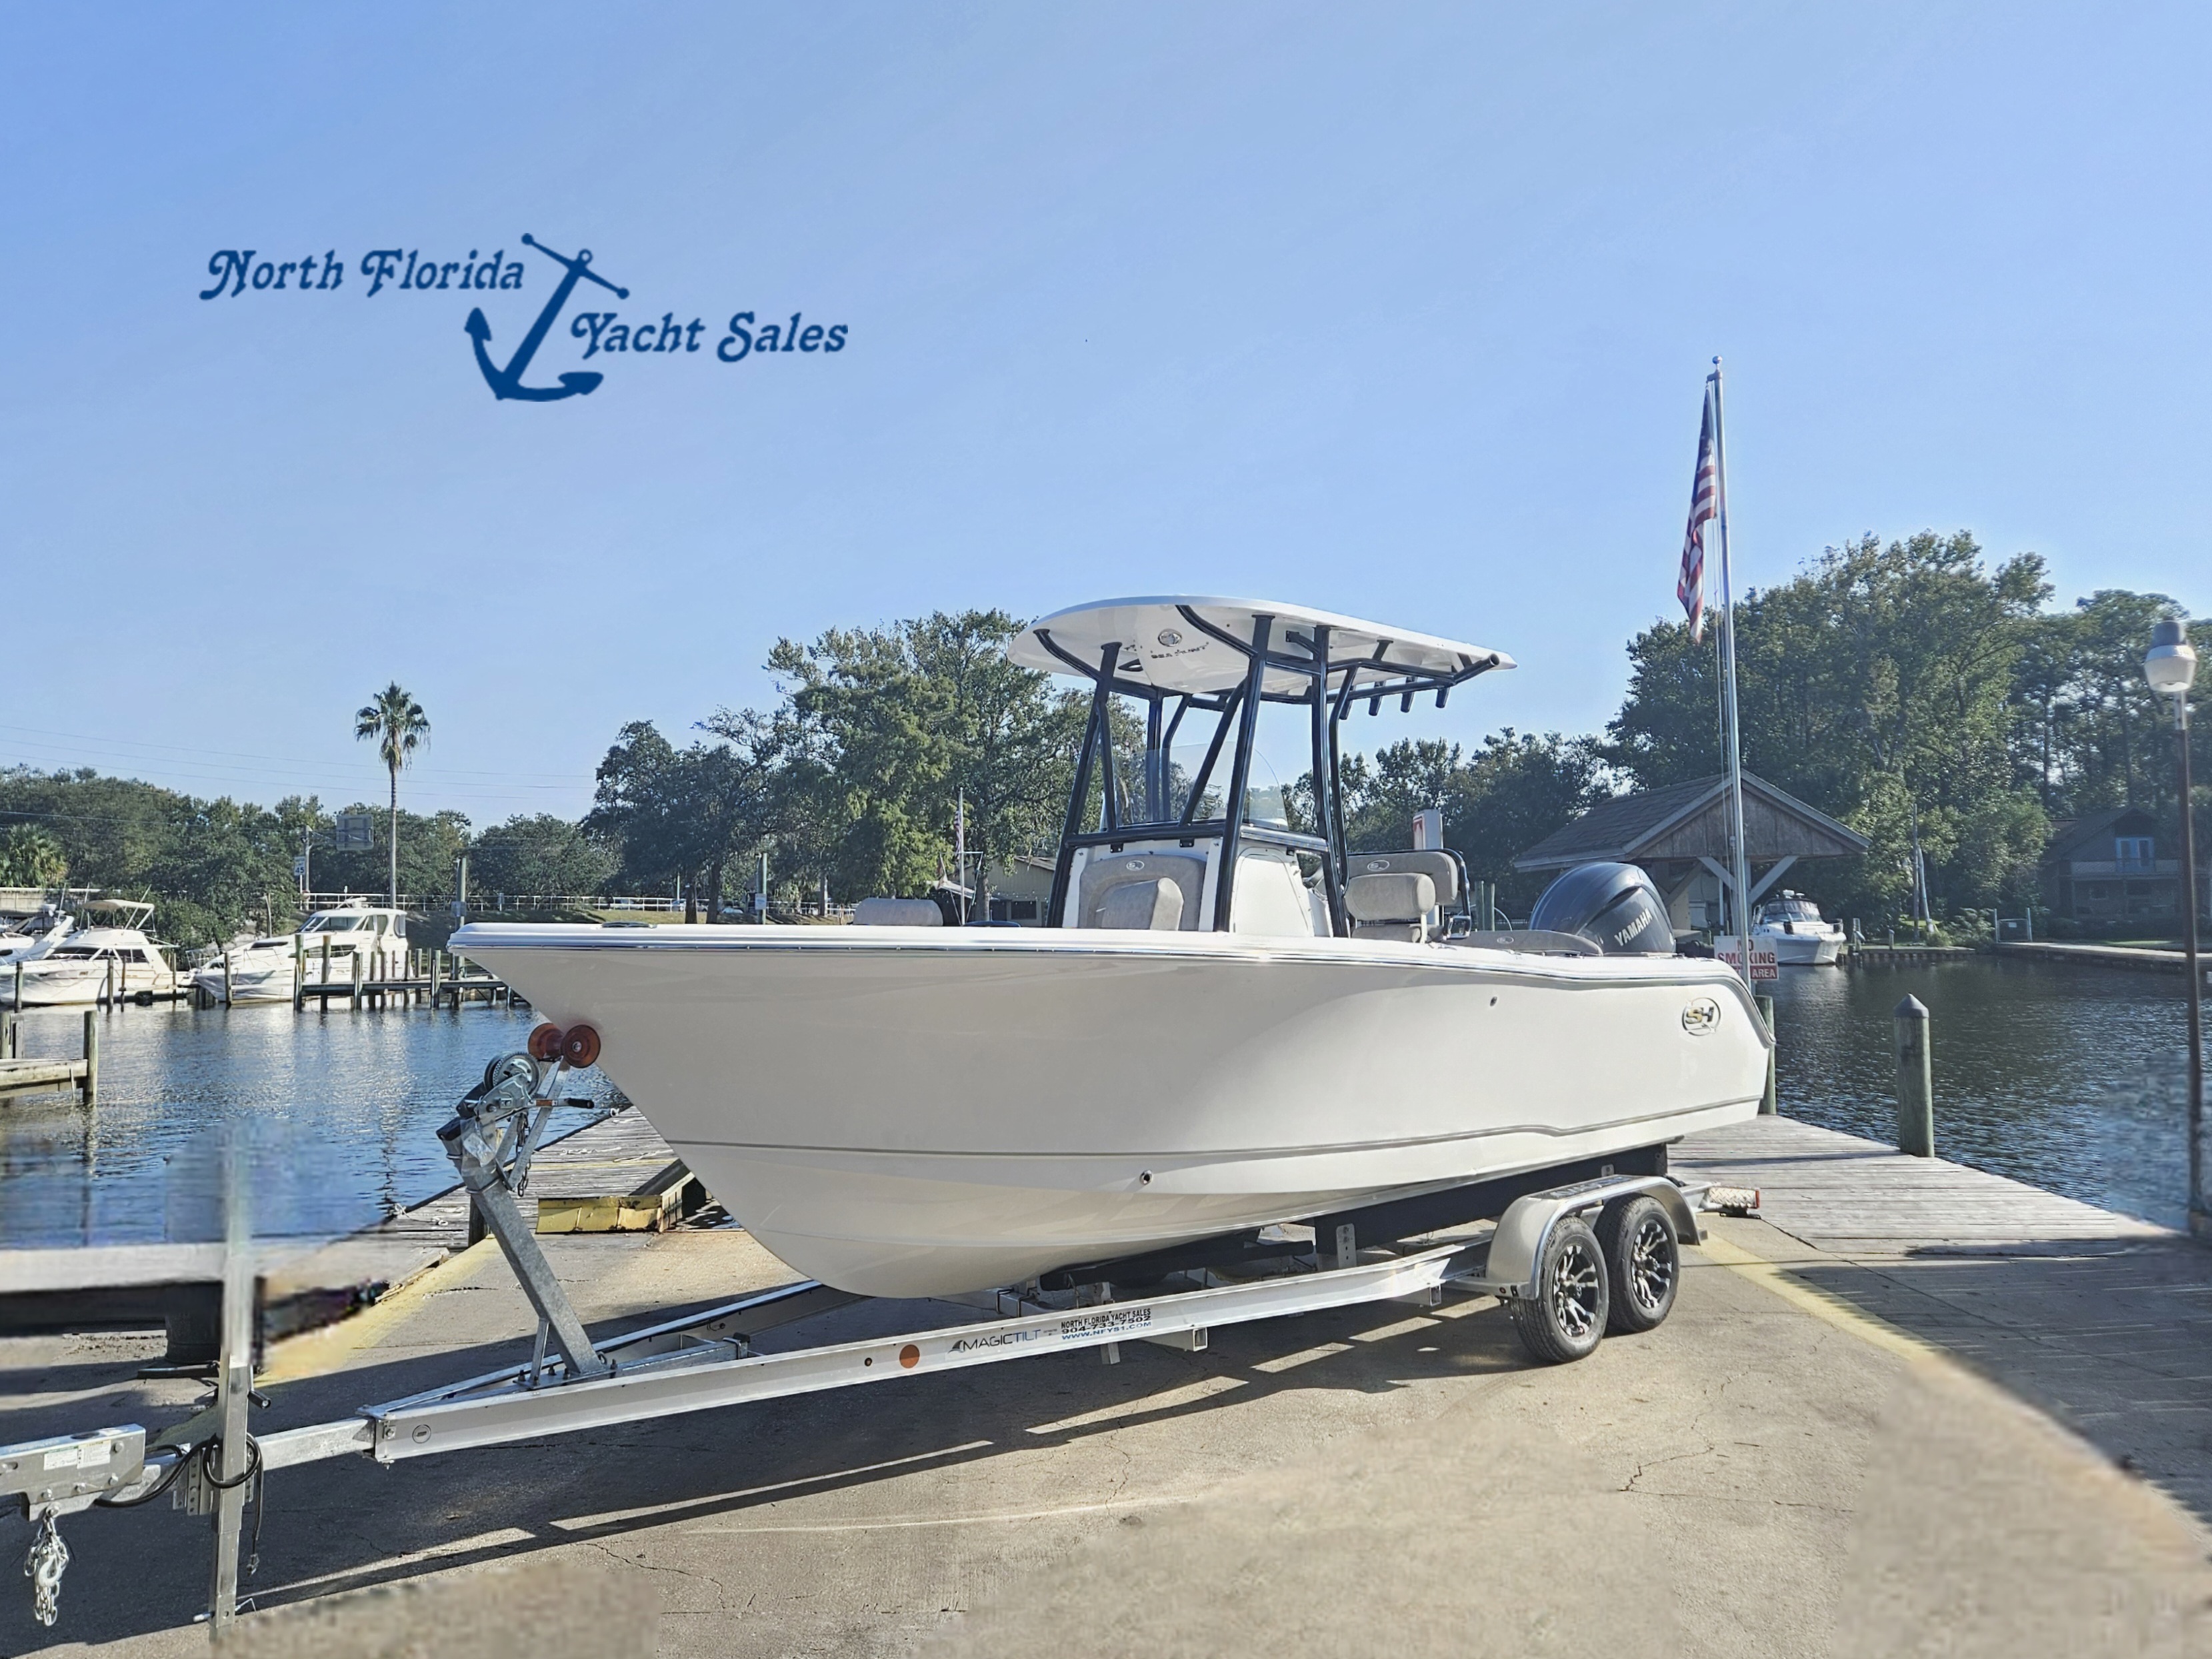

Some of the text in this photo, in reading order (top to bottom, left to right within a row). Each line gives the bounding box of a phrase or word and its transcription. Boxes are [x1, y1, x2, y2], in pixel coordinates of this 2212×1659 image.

[1614, 908, 1653, 946] YAMAHA
[1718, 952, 1775, 964] SMOKING
[1752, 969, 1776, 978] AREA
[1061, 1308, 1151, 1329] NORTH FLORIDA YACHT SALES
[1061, 1316, 1151, 1334] 904-733-7502
[963, 1330, 1041, 1351] MAGICTILT
